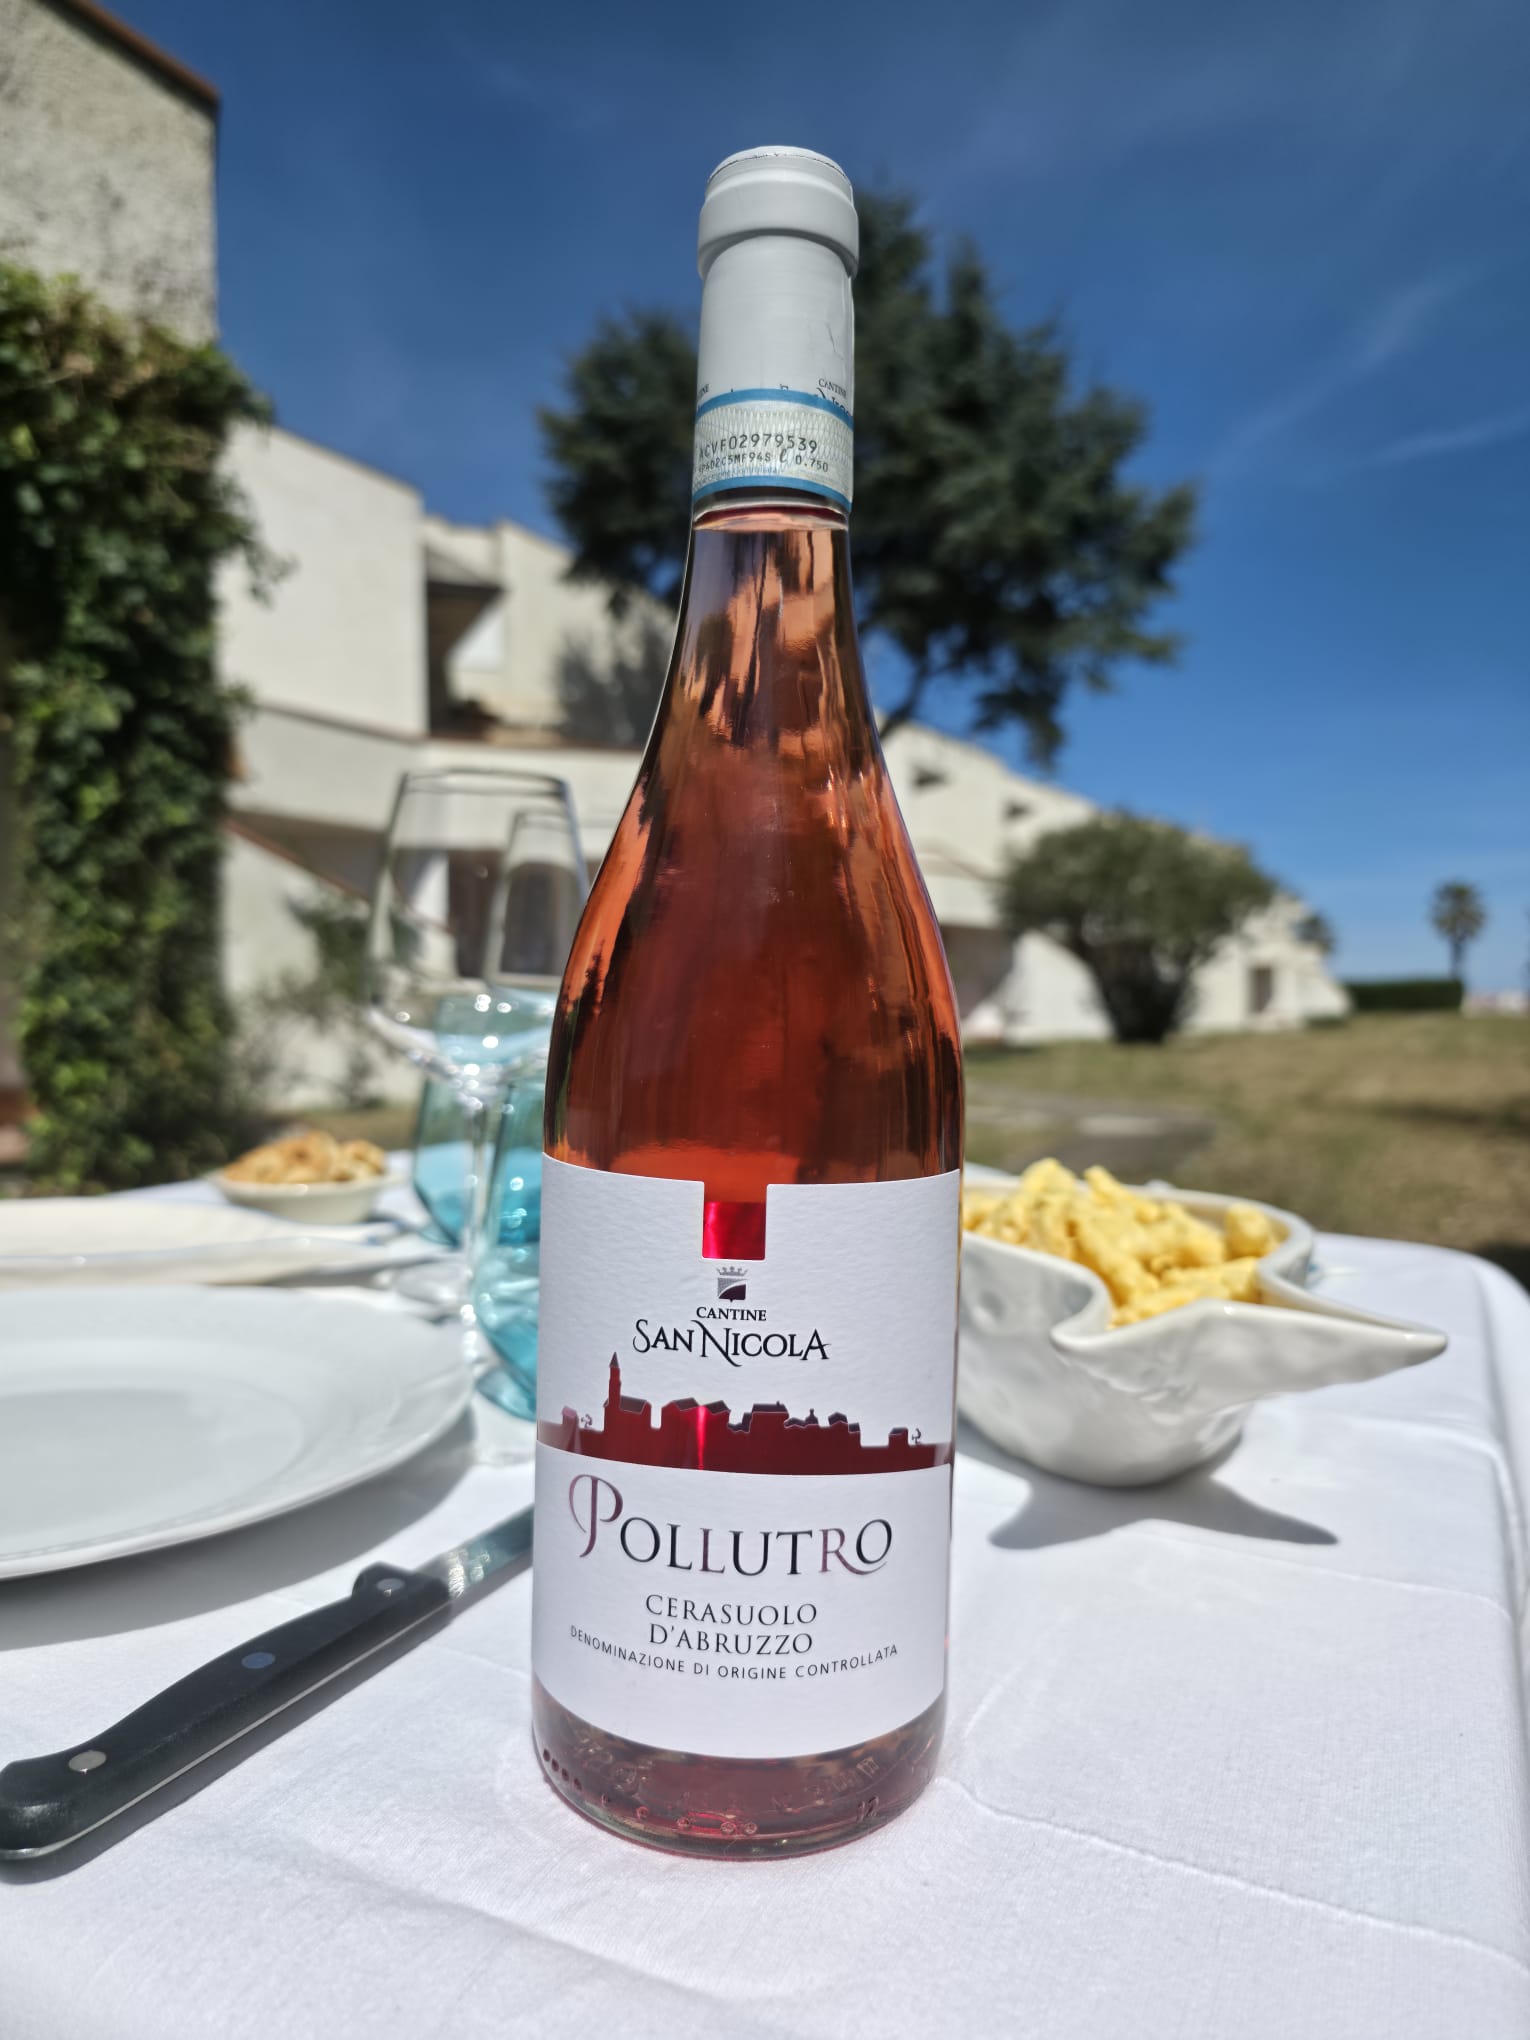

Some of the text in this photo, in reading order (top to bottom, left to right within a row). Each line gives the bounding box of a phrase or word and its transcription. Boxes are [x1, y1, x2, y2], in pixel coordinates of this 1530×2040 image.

[818, 378, 847, 399] CANTIN
[795, 455, 829, 472] 0.750
[696, 1306, 767, 1321] CANTINE
[568, 1474, 893, 1576] POLLUTRO
[646, 1594, 818, 1626] CERASUOLO
[570, 1625, 898, 1680] DENOMINAZIONE DI ORIGINE CONTROLLATA
[649, 1623, 813, 1655] D'ABRUZZO
